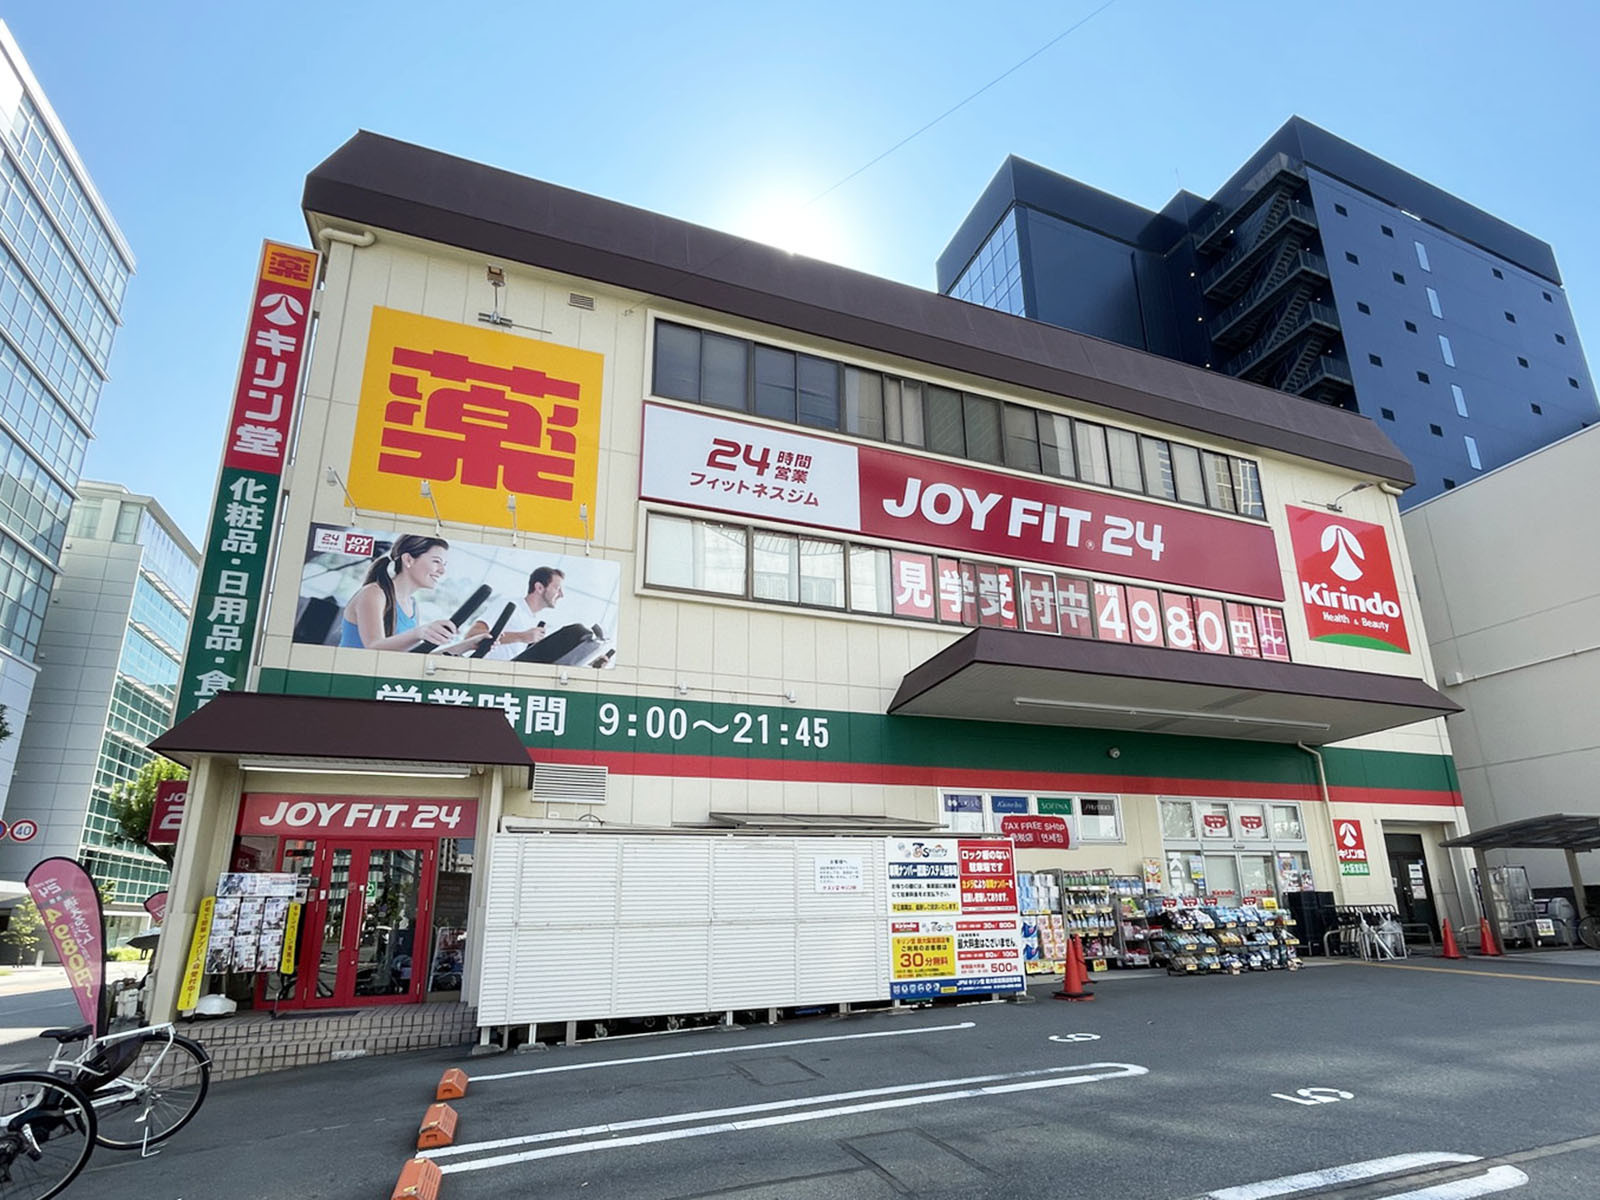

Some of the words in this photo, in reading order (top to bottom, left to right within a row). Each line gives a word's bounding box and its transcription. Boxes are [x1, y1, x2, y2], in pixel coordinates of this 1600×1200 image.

[267, 252, 311, 282] 薬
[233, 328, 296, 458] キリン堂
[377, 346, 581, 501] 薬
[706, 438, 771, 476] 24
[777, 451, 812, 469] 時間
[775, 466, 809, 484] 営業
[690, 472, 819, 507] フィットネスジム
[882, 477, 1003, 532] JOY
[1008, 497, 1092, 548] FIT
[1102, 515, 1165, 561] 24
[322, 532, 341, 541] 24
[347, 537, 372, 545] JOY
[347, 544, 369, 553] FIT
[897, 560, 1091, 630] 見学受付中
[1302, 581, 1401, 618] Kirindo
[1323, 611, 1350, 624] Health
[1361, 617, 1390, 632] Beauty
[260, 801, 345, 828] JOY
[344, 803, 409, 829] FIT
[411, 805, 462, 829] 24
[1004, 822, 1019, 830] TAX
[1020, 821, 1042, 831] FREE
[1044, 823, 1065, 832] SHOP
[16, 826, 32, 836] 40
